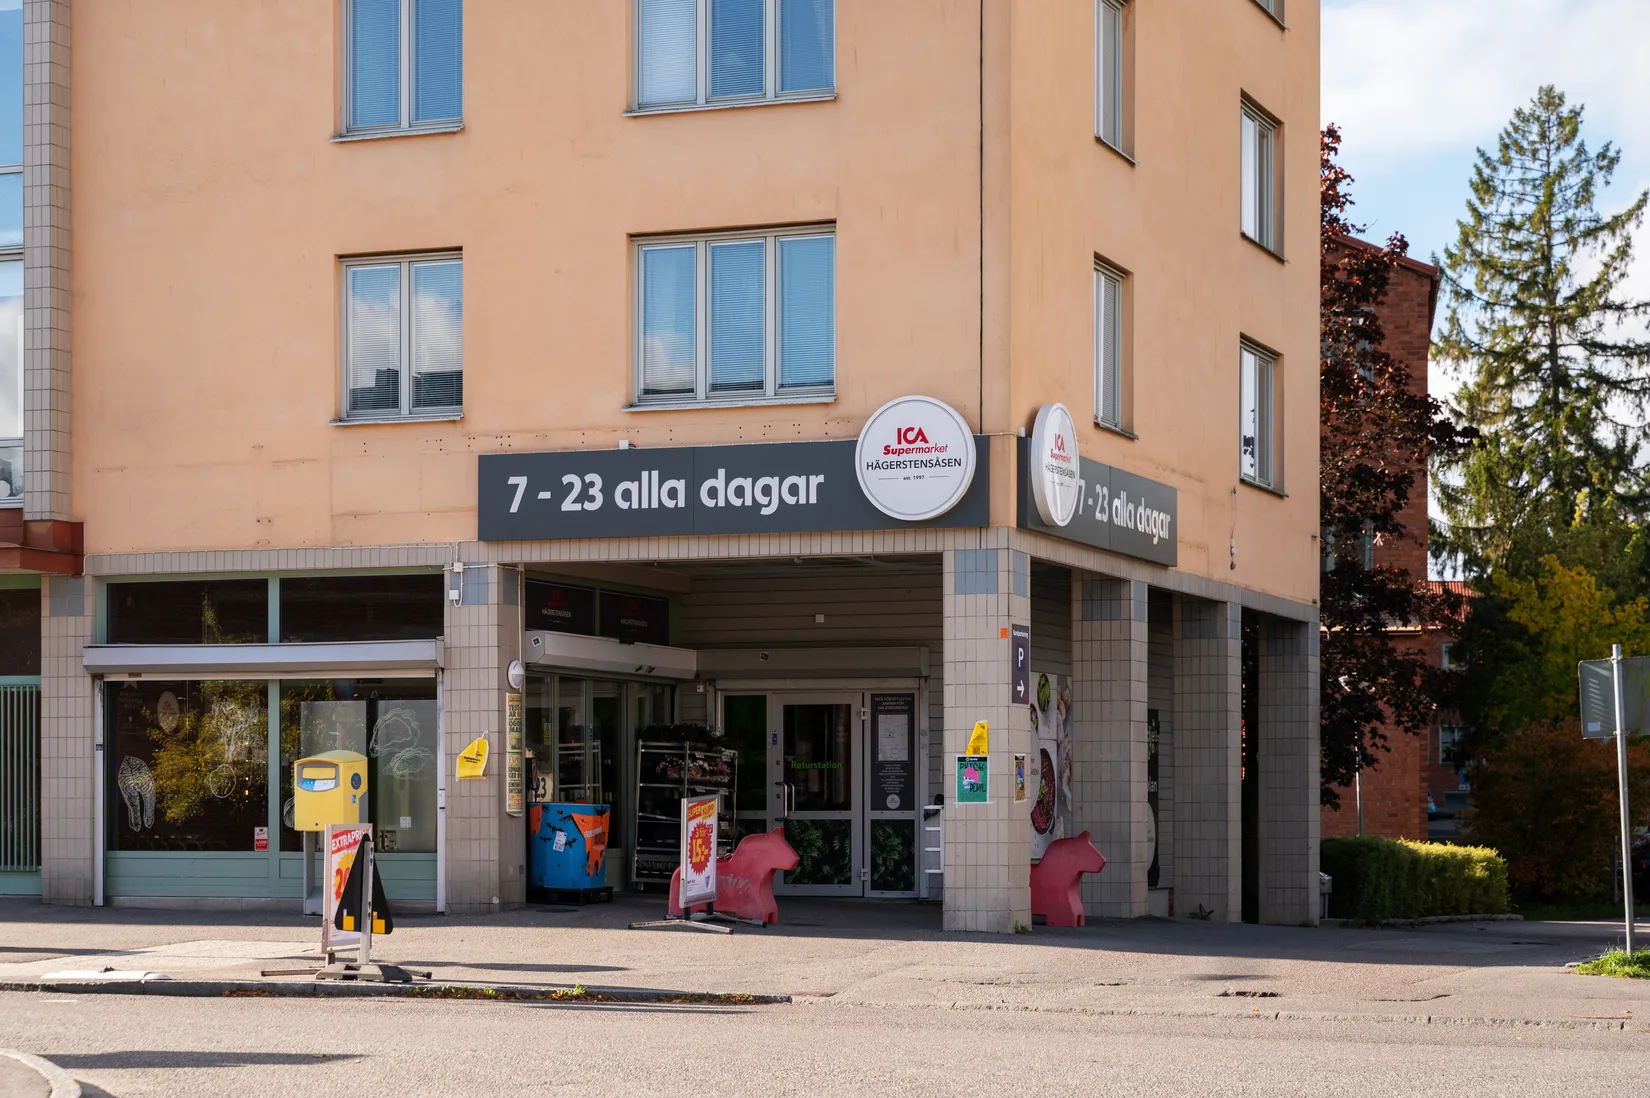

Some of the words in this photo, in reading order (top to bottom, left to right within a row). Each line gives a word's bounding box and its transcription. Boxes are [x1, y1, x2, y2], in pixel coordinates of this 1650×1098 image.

[897, 427, 929, 445] ICA
[1054, 433, 1065, 452] ICA
[883, 443, 948, 457] Supermarket
[866, 457, 962, 471] HÄGERSTENSÅSEN
[507, 477, 528, 513] 7
[560, 473, 604, 512] 23
[614, 470, 686, 511] alla
[700, 468, 824, 516] dagar
[1095, 484, 1109, 522] 23
[1112, 491, 1134, 530] alla
[1136, 497, 1171, 545] dagar
[1018, 647, 1024, 668] P
[791, 761, 842, 769] Returstation
